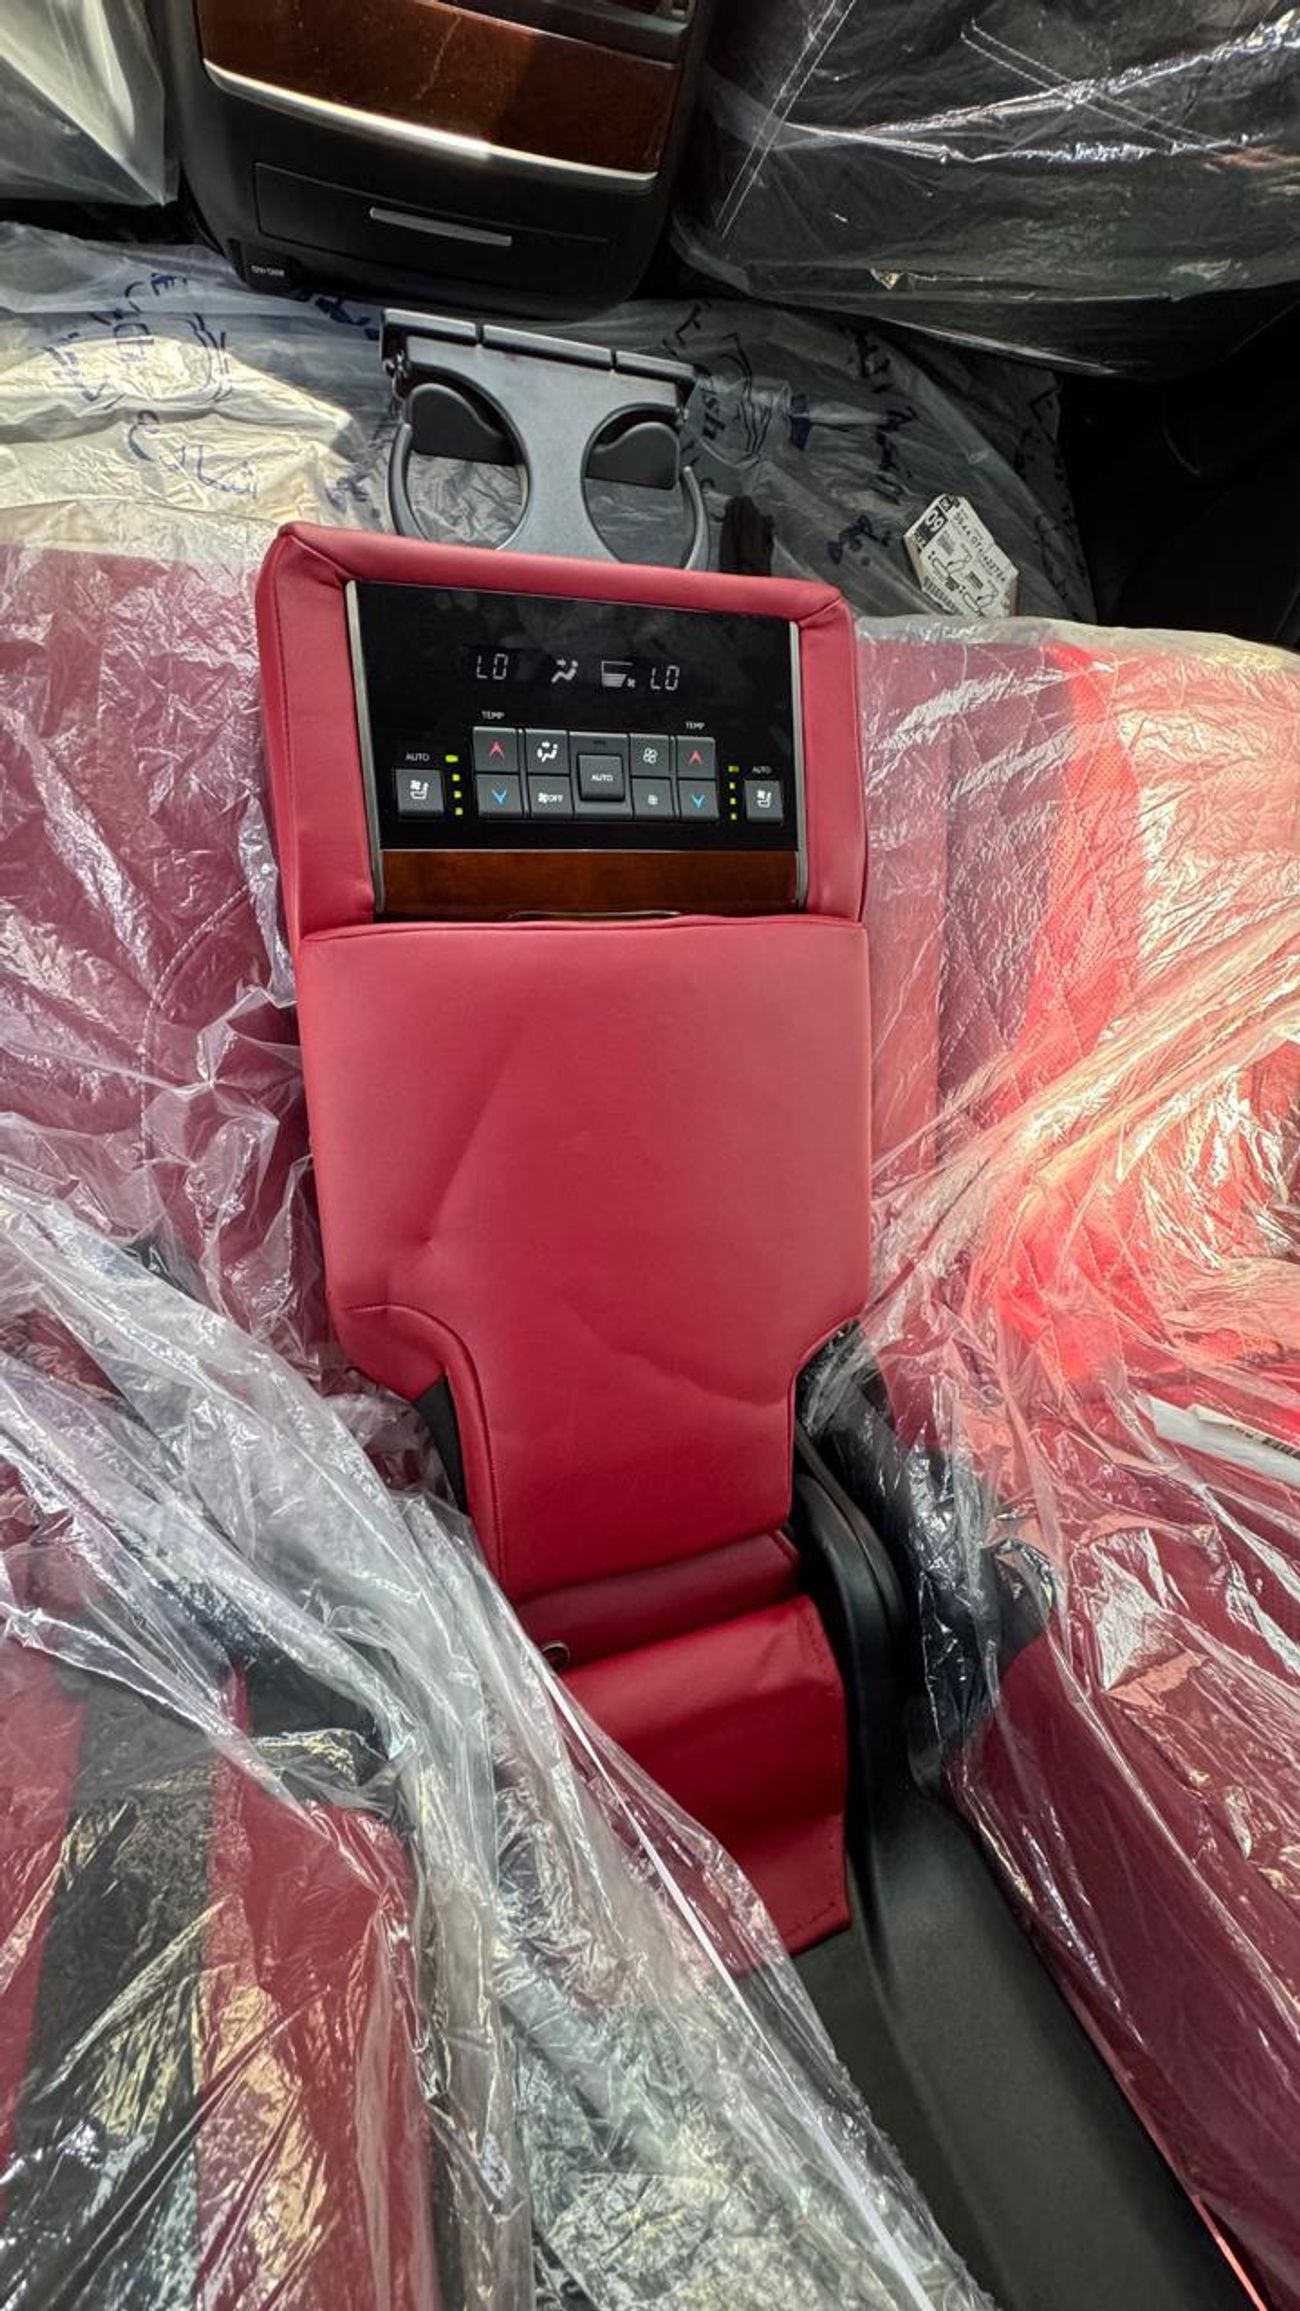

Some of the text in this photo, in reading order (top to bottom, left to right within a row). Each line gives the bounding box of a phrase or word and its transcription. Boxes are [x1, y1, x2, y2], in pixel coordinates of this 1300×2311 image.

[476, 653, 508, 680] LO
[650, 665, 680, 691] LO
[481, 710, 504, 720] TEMP
[685, 721, 706, 730] TEMP
[405, 753, 430, 762] AUTO
[752, 766, 773, 774] AUTO
[591, 773, 613, 782] AUTO
[547, 794, 564, 803] OFF
